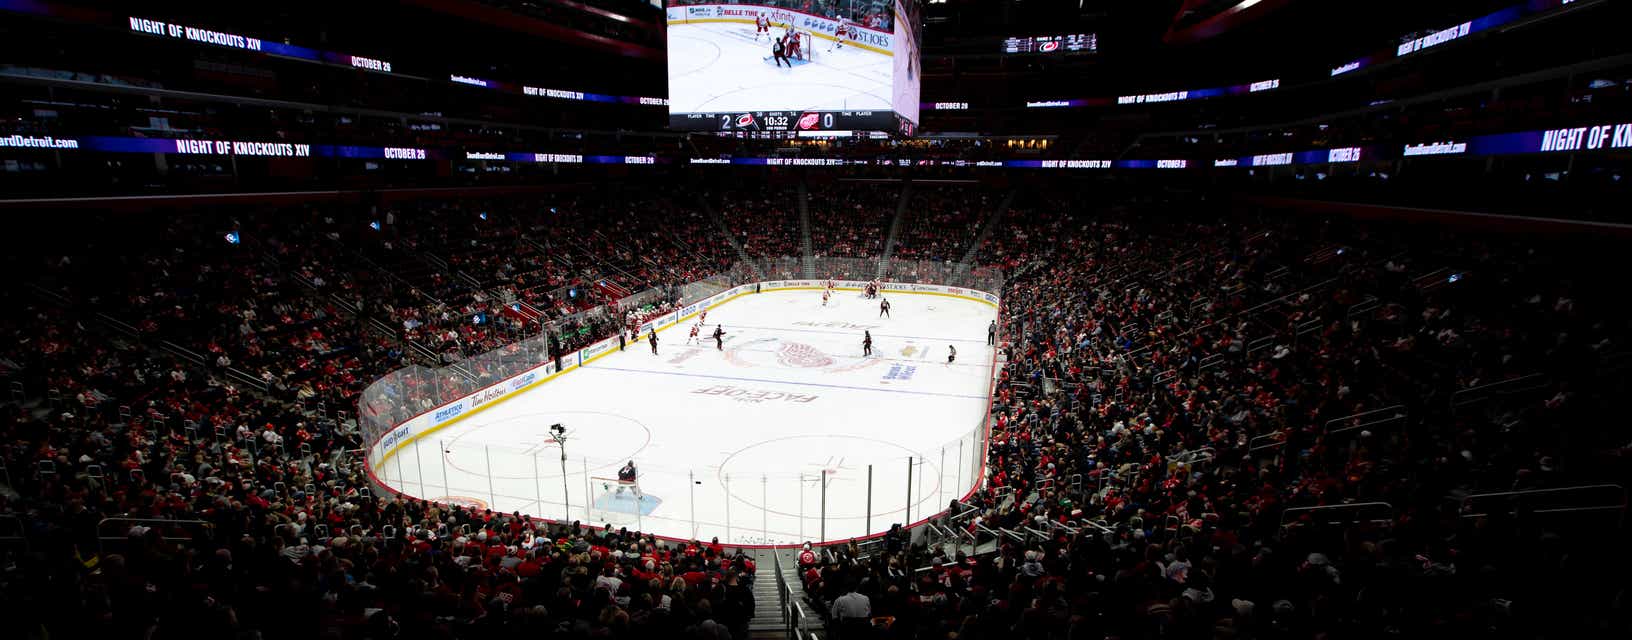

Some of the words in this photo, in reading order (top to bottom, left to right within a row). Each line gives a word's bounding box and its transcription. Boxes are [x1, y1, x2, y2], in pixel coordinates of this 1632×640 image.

[770, 9, 796, 24] xfinity
[129, 16, 166, 35] NIGHT
[168, 23, 184, 38] OF
[185, 26, 245, 48] KNOCKOUTS
[246, 38, 261, 51] XIV
[351, 55, 382, 71] OCTOBER
[539, 87, 546, 97] OF
[546, 88, 575, 99] KNOCKOUTS
[639, 96, 663, 105] OCTOBER
[935, 102, 961, 110] OCTOBER
[722, 115, 731, 129] 2
[763, 116, 788, 126] 10:32
[824, 113, 833, 128] 0
[1540, 127, 1587, 151] NIGHT
[1587, 124, 1611, 150] OF
[176, 139, 213, 154] NIGHT
[215, 140, 231, 155] OF
[233, 141, 293, 156] KNOCKOUTS
[294, 144, 310, 157] XIV
[384, 147, 416, 159] OCTOBER
[417, 149, 426, 159] 26
[624, 155, 647, 164] OCTOBER
[1042, 160, 1058, 168] NIGHT
[1059, 160, 1067, 168] OF
[1067, 160, 1100, 168] KNOCKOUTS
[1101, 160, 1111, 168] XIV
[471, 395, 484, 408] Tim
